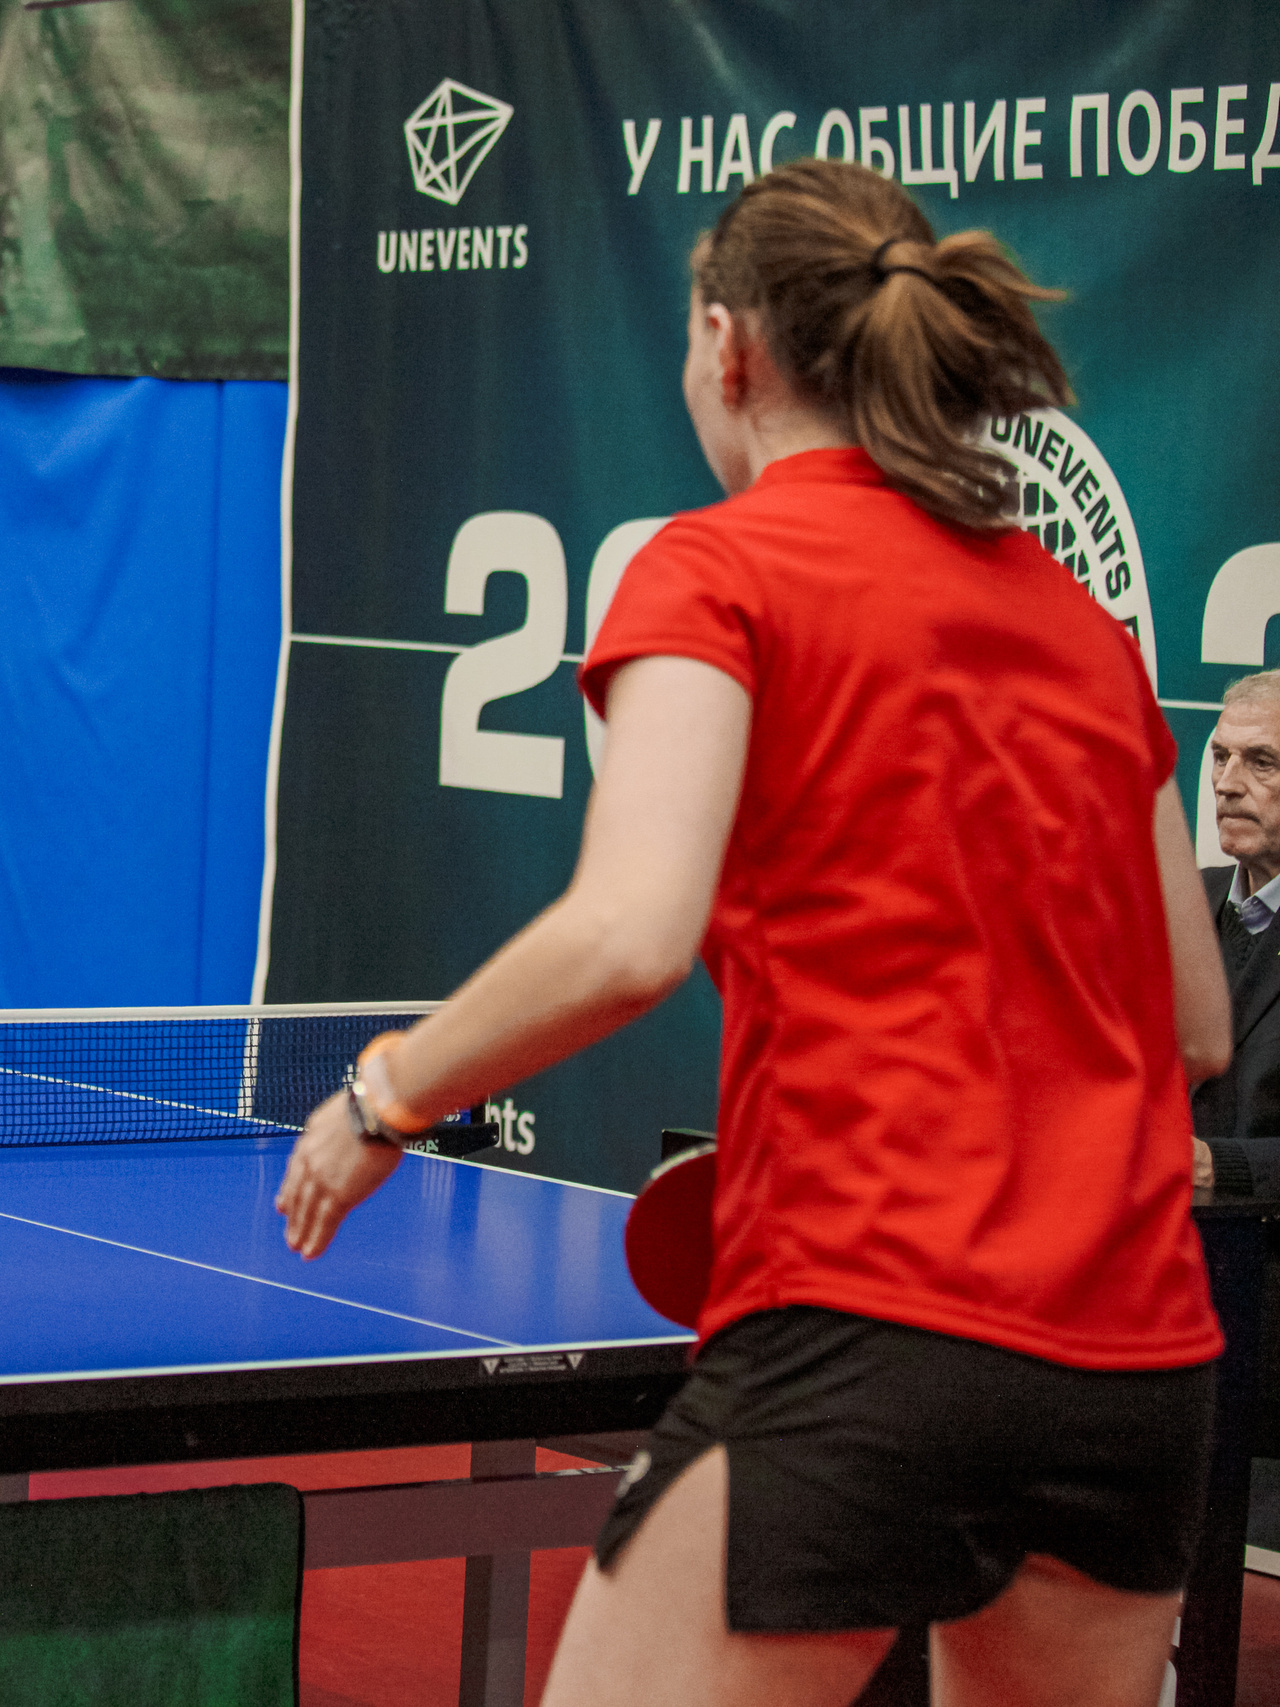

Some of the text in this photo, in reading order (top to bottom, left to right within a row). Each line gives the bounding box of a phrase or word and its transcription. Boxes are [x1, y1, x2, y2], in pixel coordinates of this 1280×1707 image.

[622, 117, 662, 196] У
[677, 110, 797, 194] НАС
[815, 96, 1046, 199] ОБЩИЕ
[377, 223, 529, 274] UNEVENTS
[990, 412, 1132, 600] UNEVENTS
